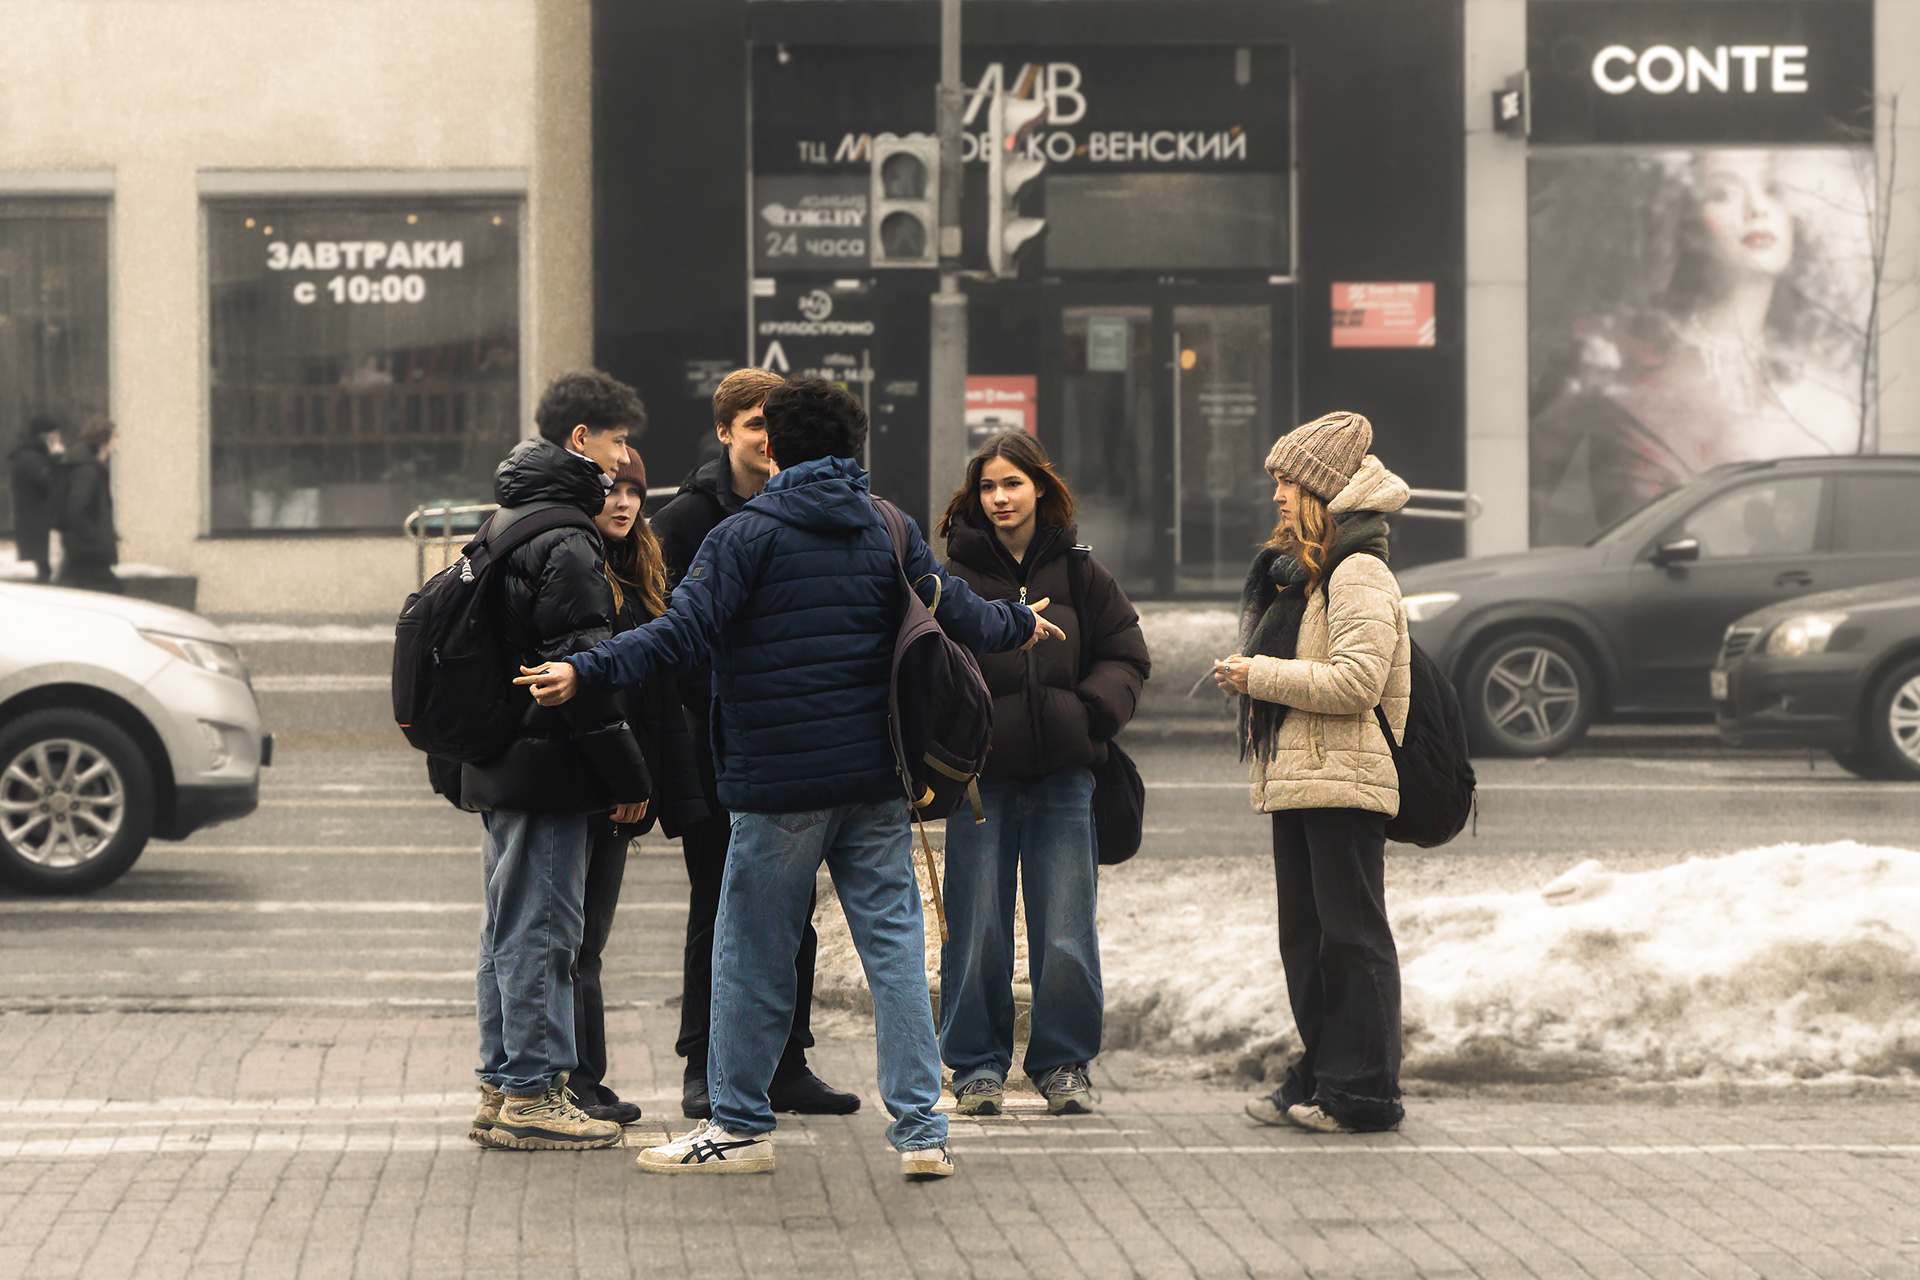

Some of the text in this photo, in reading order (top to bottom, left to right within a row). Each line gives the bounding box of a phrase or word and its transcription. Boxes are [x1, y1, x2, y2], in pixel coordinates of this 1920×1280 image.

[1592, 44, 1809, 94] CONTE
[799, 142, 827, 164] ТЦ
[266, 241, 464, 270] ЗАВТРАКИ
[766, 231, 866, 257] 24 часа
[293, 275, 426, 304] с 10:00
